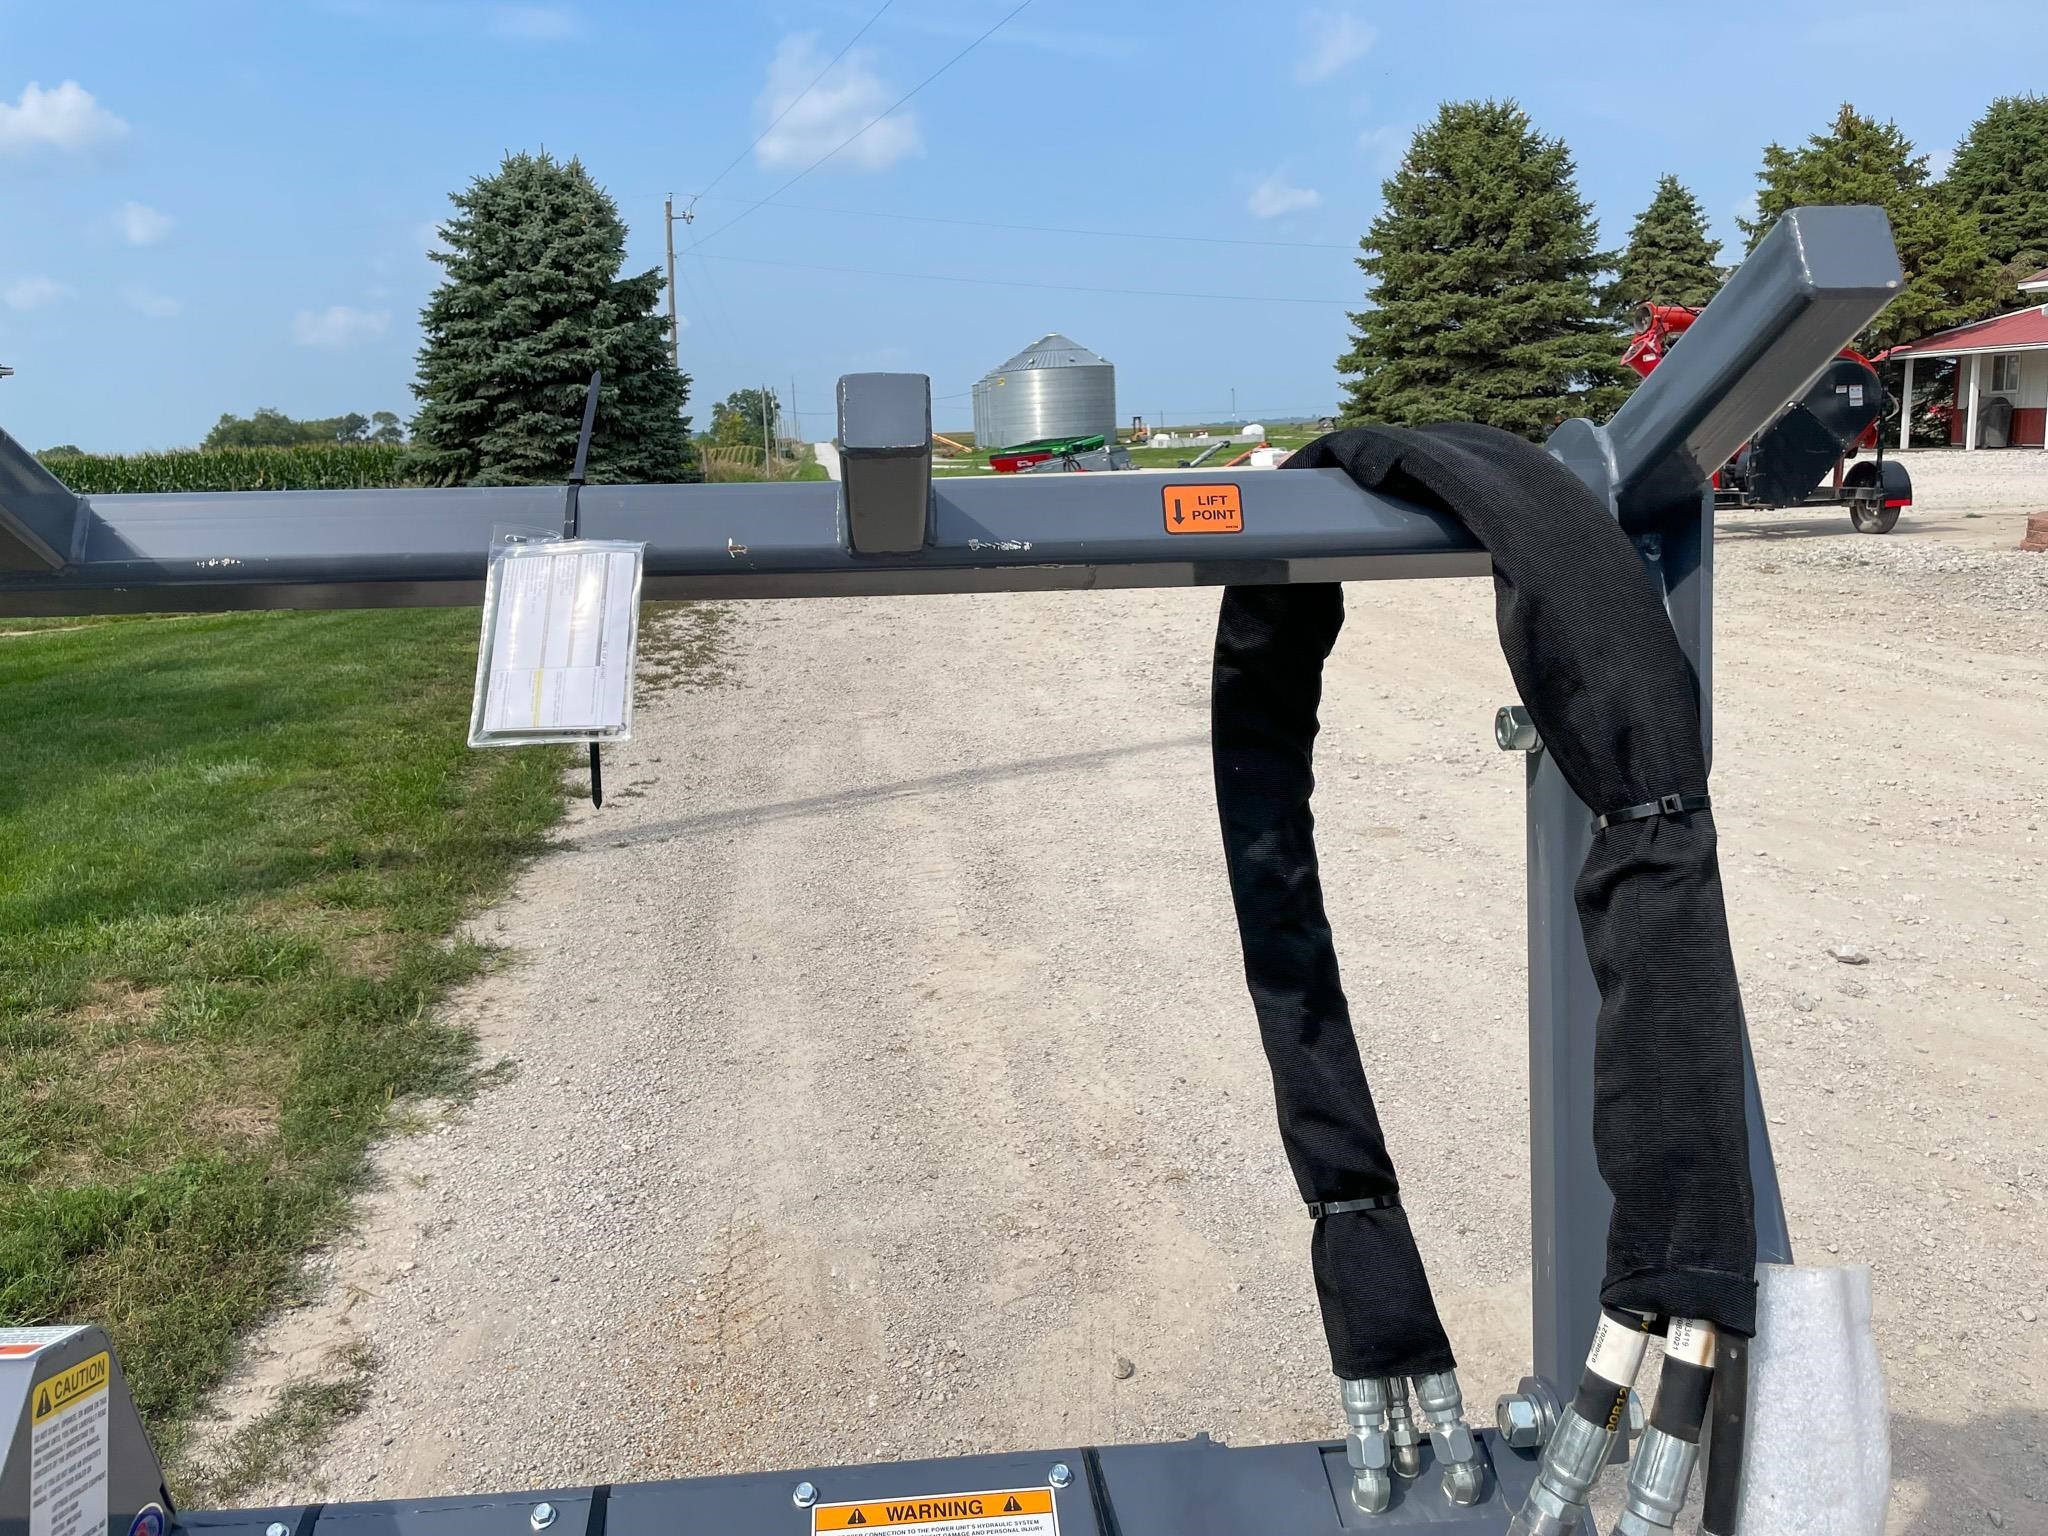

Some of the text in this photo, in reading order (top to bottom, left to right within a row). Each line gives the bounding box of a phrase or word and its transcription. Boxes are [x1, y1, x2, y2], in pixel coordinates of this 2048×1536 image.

[1197, 495, 1228, 506] LIFT
[1192, 509, 1236, 521] POINT
[54, 1358, 105, 1400] CAUTION
[886, 1499, 983, 1522] WARNING
[976, 1521, 1013, 1529] HYDRAULIC
[1014, 1519, 1040, 1527] SYSTEM
[986, 1527, 1020, 1535] PERSONAL
